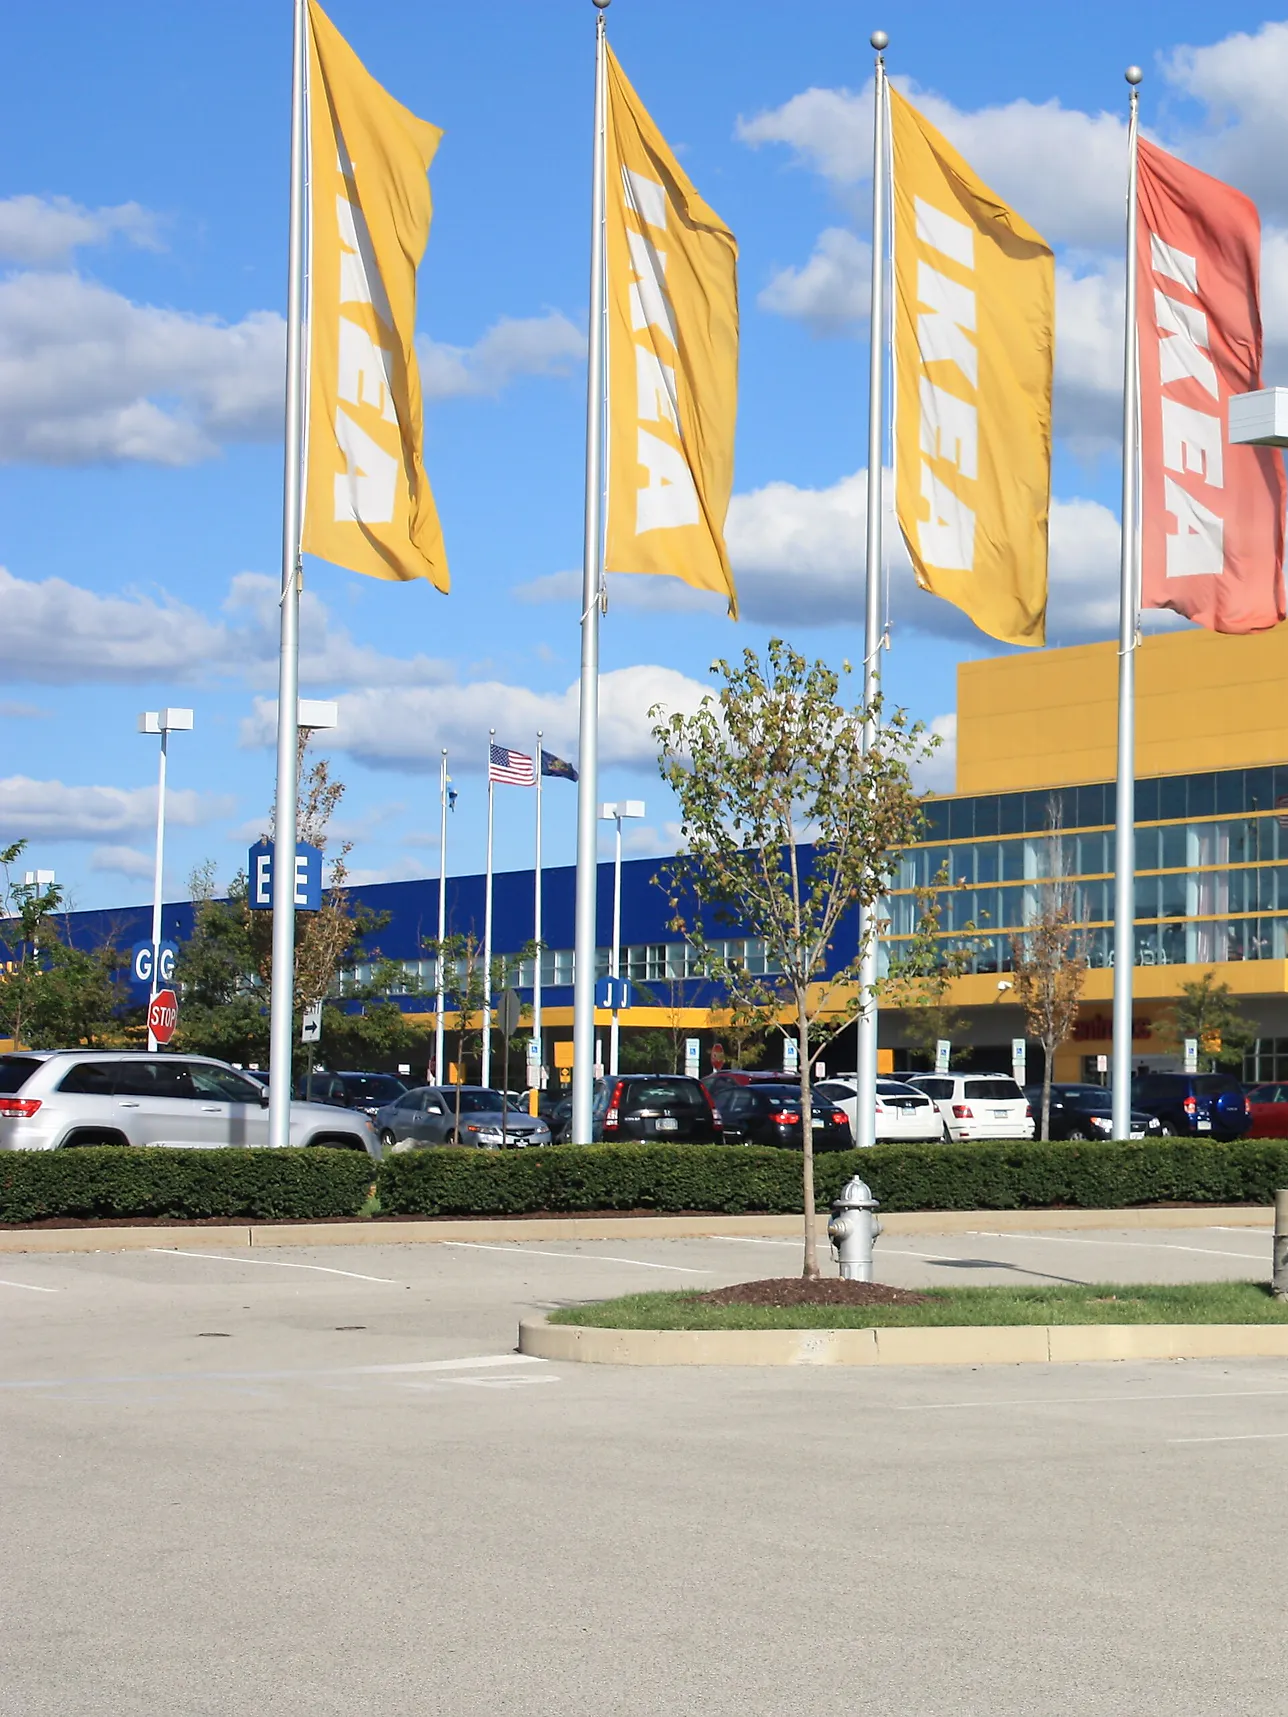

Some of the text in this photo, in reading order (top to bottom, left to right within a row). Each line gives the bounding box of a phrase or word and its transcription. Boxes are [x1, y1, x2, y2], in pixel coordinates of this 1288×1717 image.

[623, 164, 700, 535] IKEA
[915, 195, 978, 571] IKEA
[1151, 232, 1225, 578] IKEA
[256, 855, 271, 903] E
[294, 856, 308, 904] E
[135, 949, 152, 980] G
[160, 949, 175, 979] G
[603, 982, 612, 1007] J
[621, 983, 628, 1007] J
[151, 1005, 176, 1028] STOP
